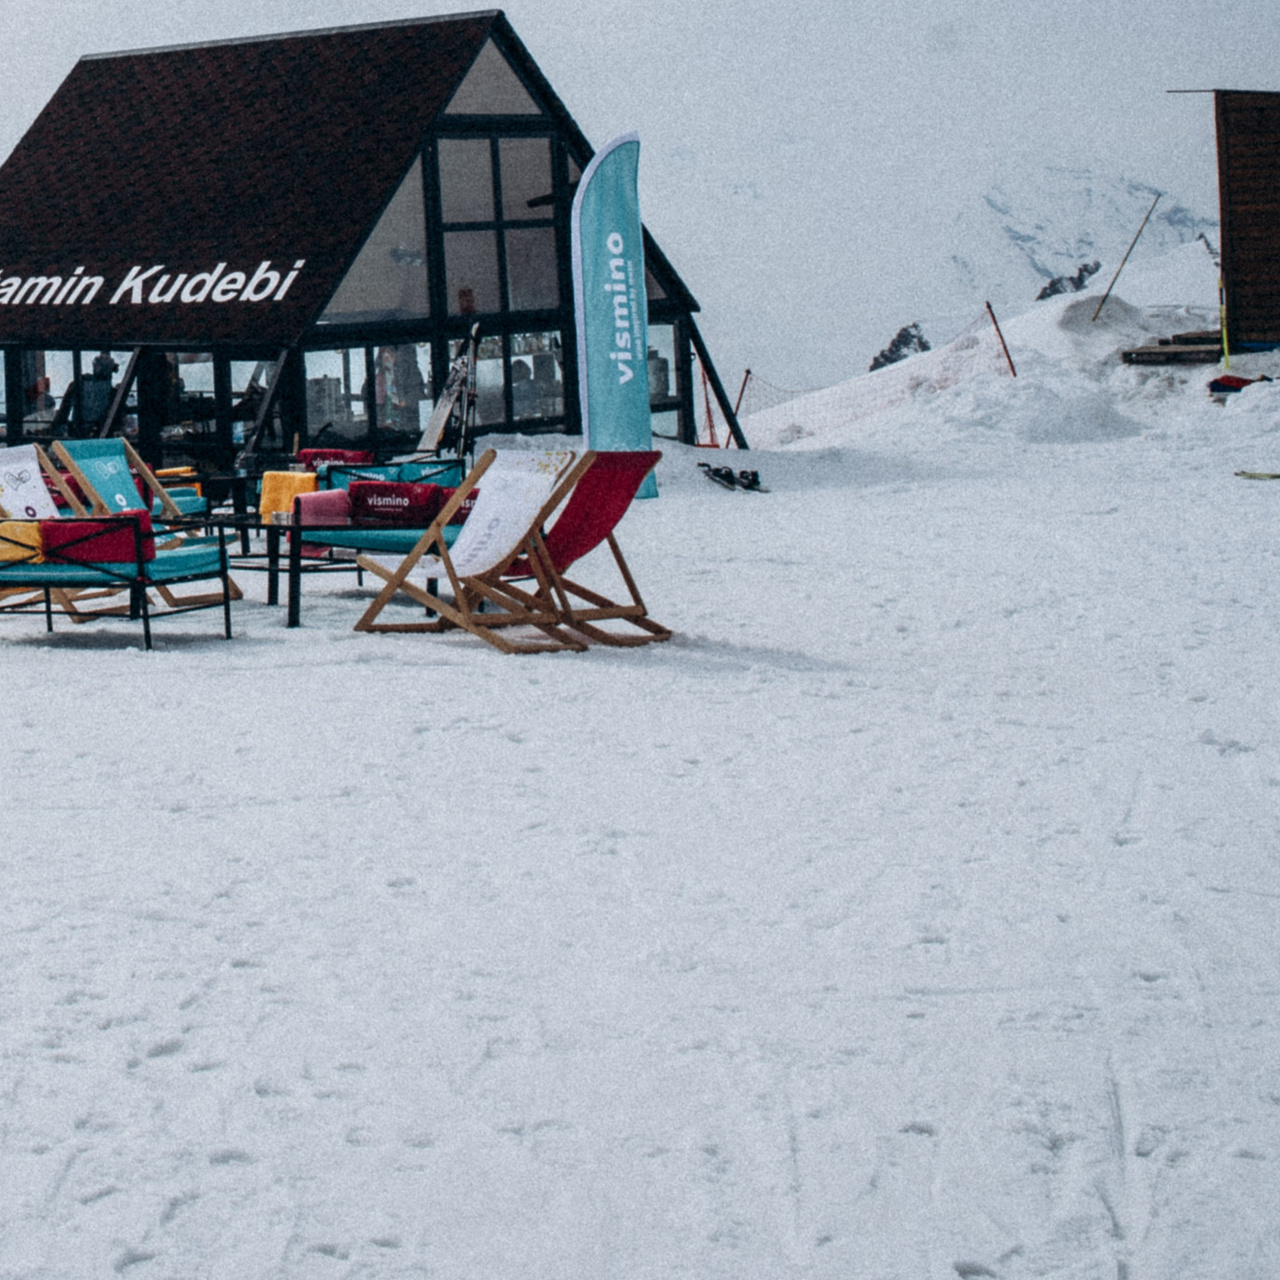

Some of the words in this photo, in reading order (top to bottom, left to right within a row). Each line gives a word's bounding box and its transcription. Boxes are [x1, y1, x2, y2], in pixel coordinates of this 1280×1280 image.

[109, 259, 306, 305] Kudebi
[604, 232, 634, 385] vismino
[366, 494, 410, 507] vismino
